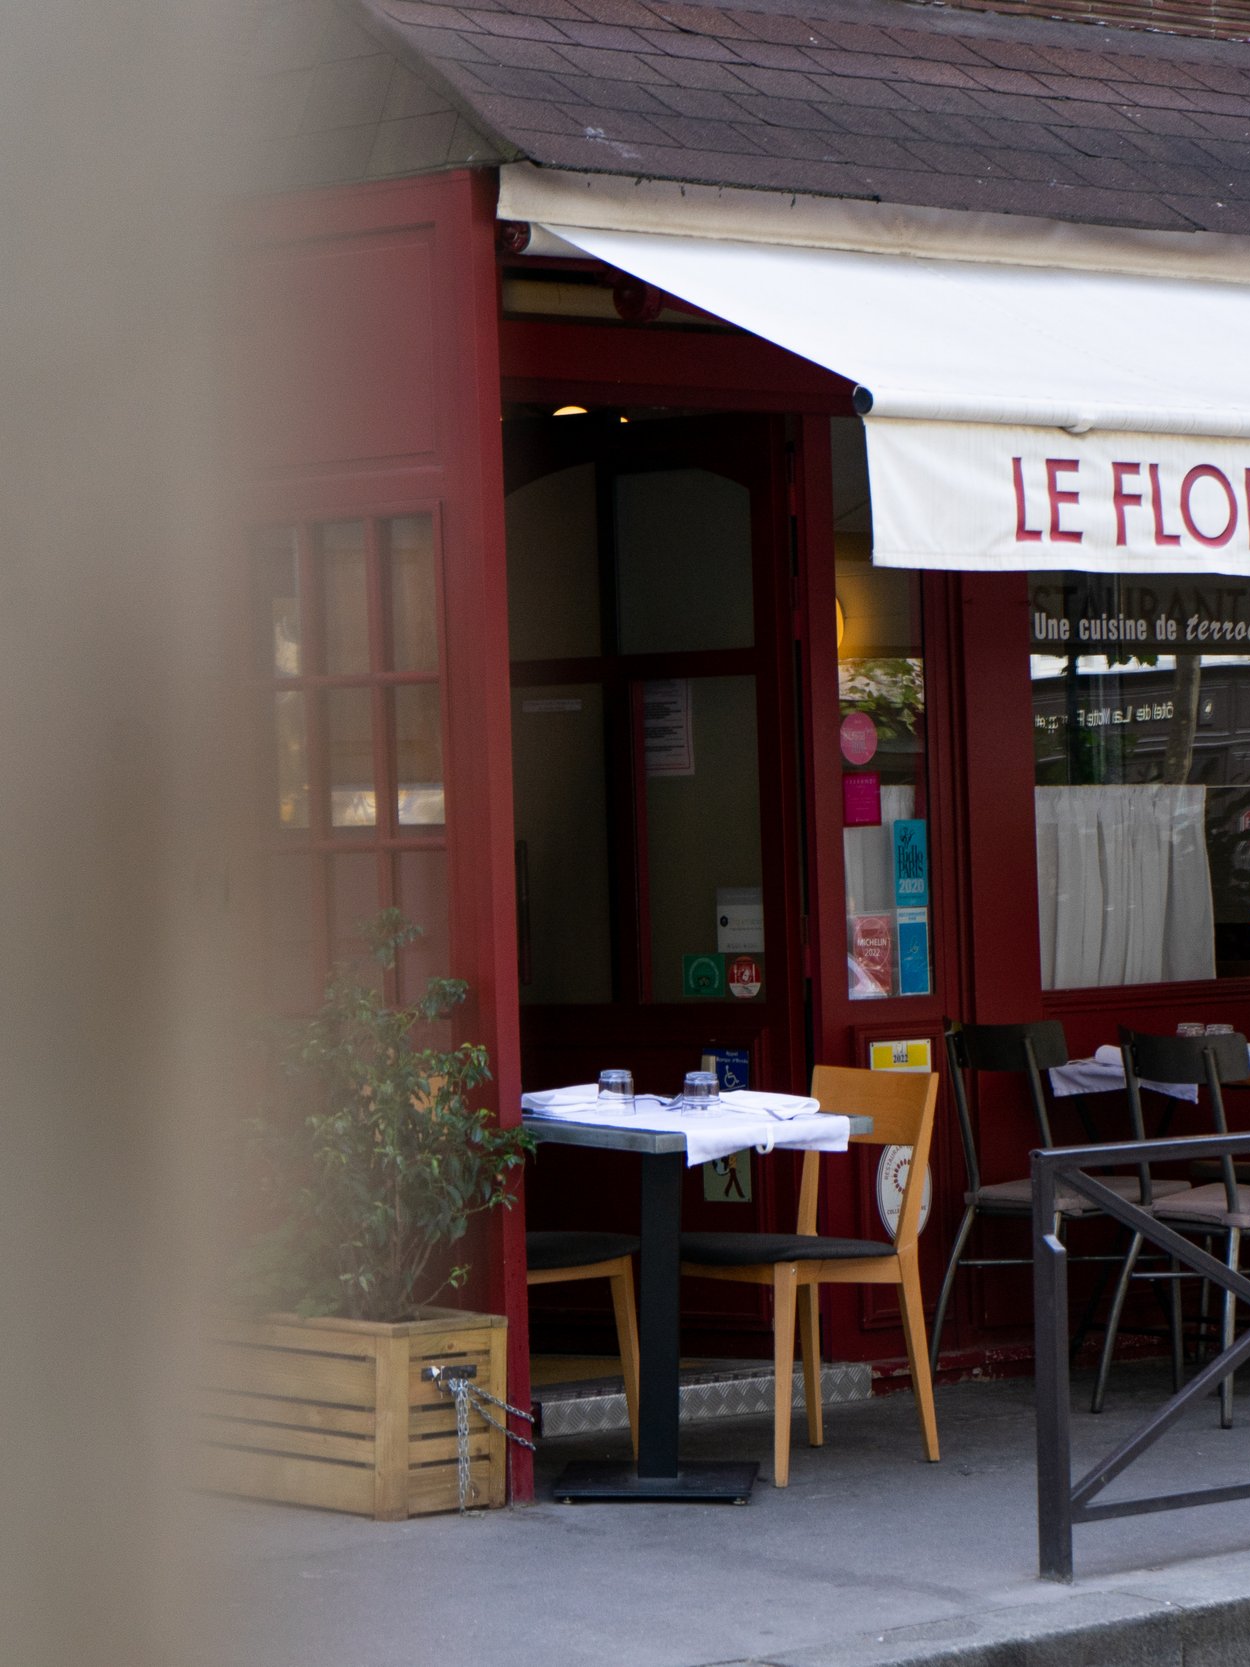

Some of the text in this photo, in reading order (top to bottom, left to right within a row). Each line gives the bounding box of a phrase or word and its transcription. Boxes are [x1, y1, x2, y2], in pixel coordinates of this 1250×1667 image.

[1012, 456, 1083, 542] LE
[1034, 612, 1070, 641] Une
[1078, 613, 1147, 641] cuisine
[1156, 613, 1177, 641] de
[857, 938, 887, 947] MICHELIN
[864, 948, 881, 957] 2022
